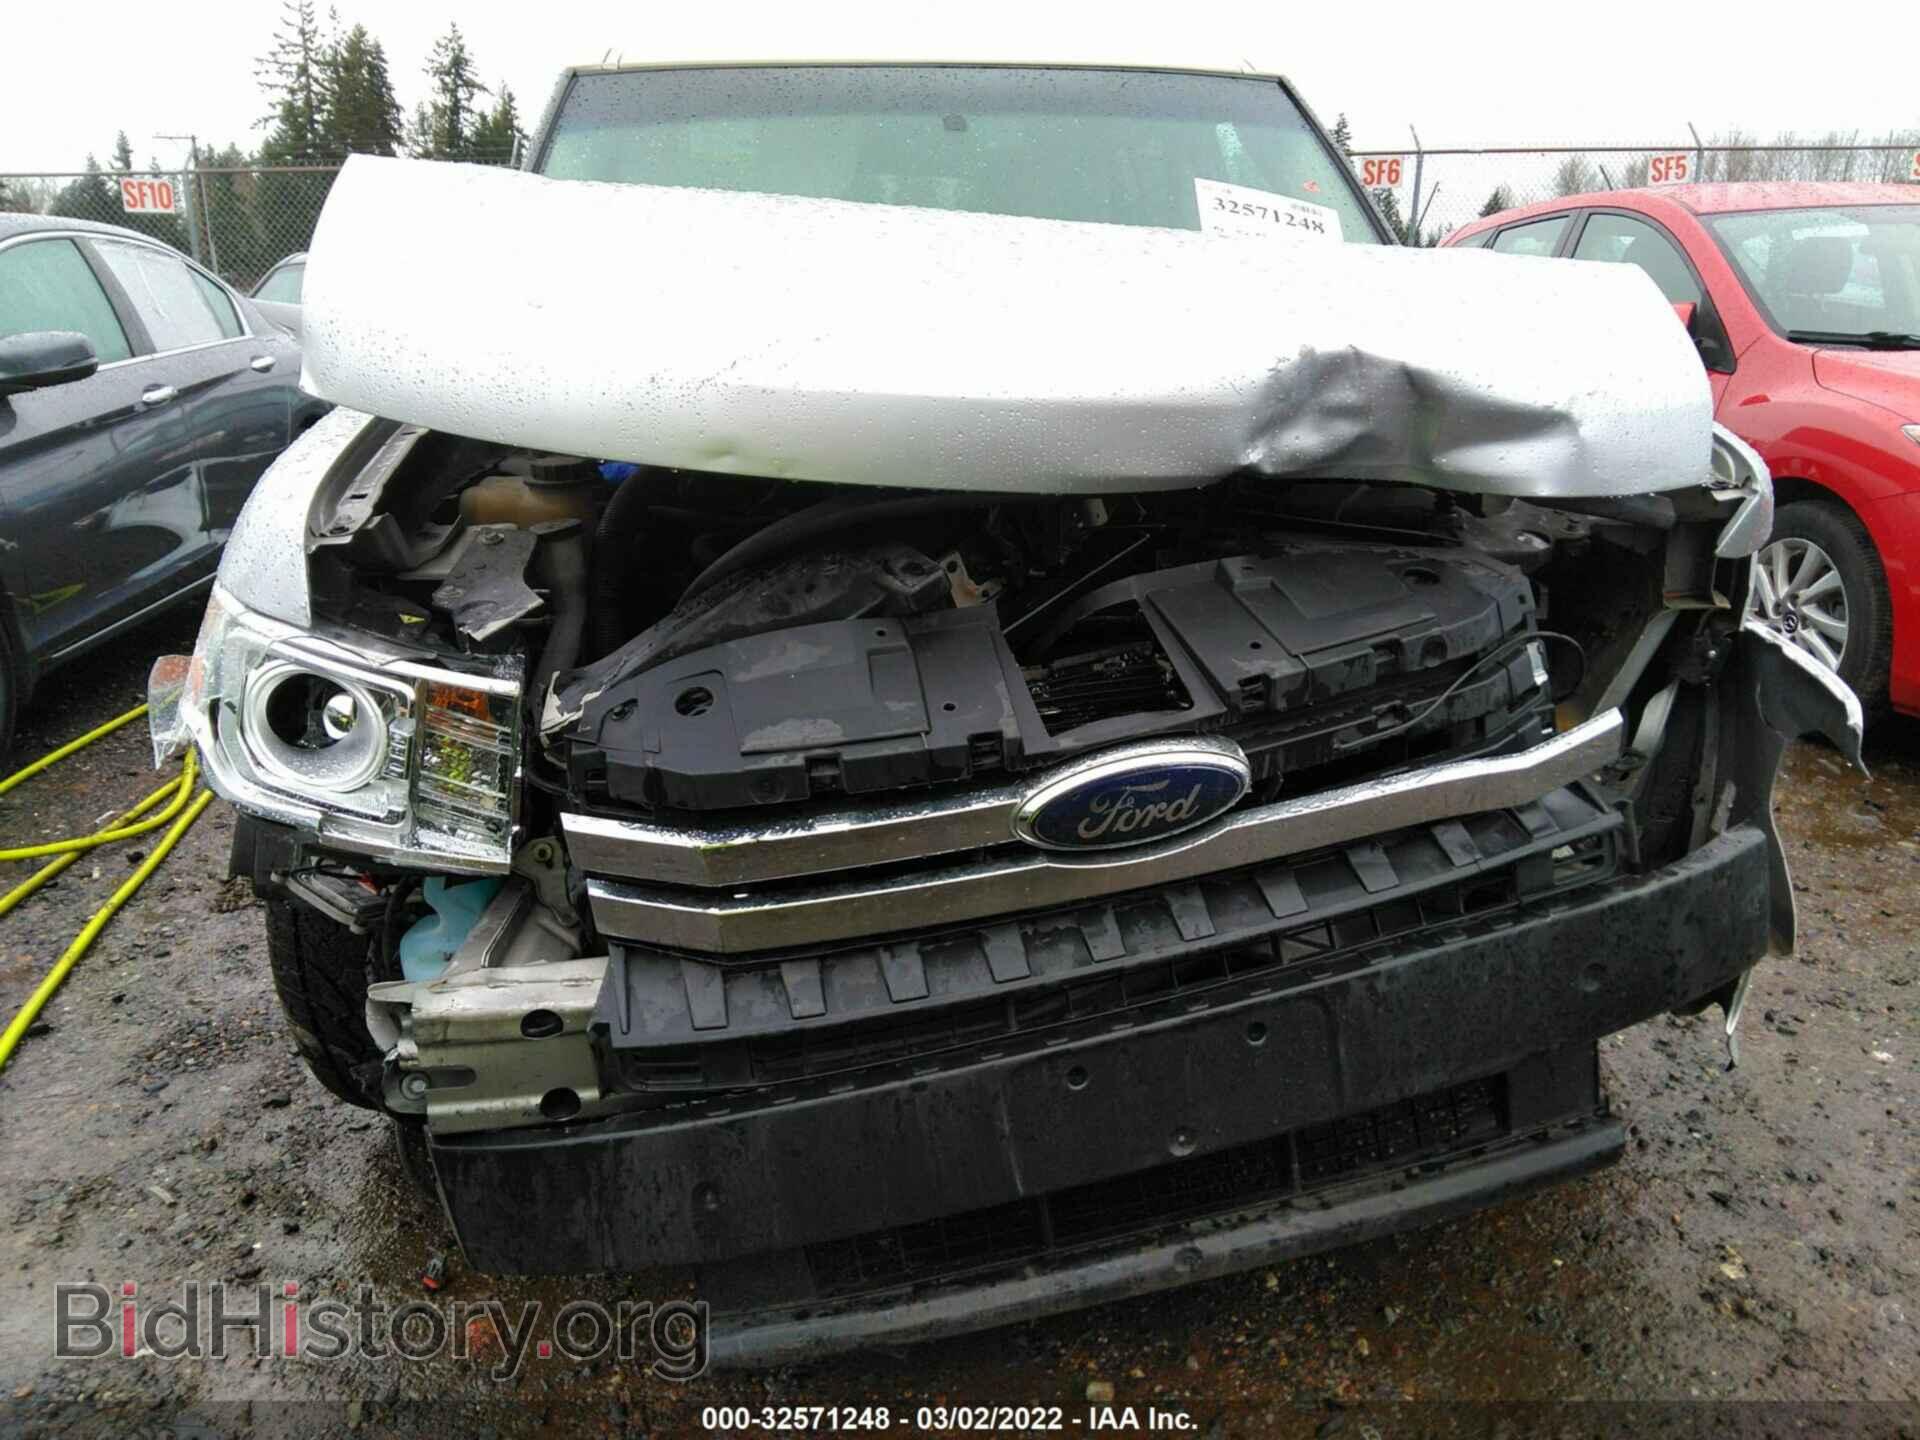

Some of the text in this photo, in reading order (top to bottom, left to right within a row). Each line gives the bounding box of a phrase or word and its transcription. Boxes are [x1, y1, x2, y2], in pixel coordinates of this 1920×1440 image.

[1362, 158, 1401, 186] SF6
[1651, 154, 1688, 183] SF5
[122, 180, 173, 210] SF10
[1213, 196, 1326, 234] 32571248
[1076, 779, 1203, 840] Ford
